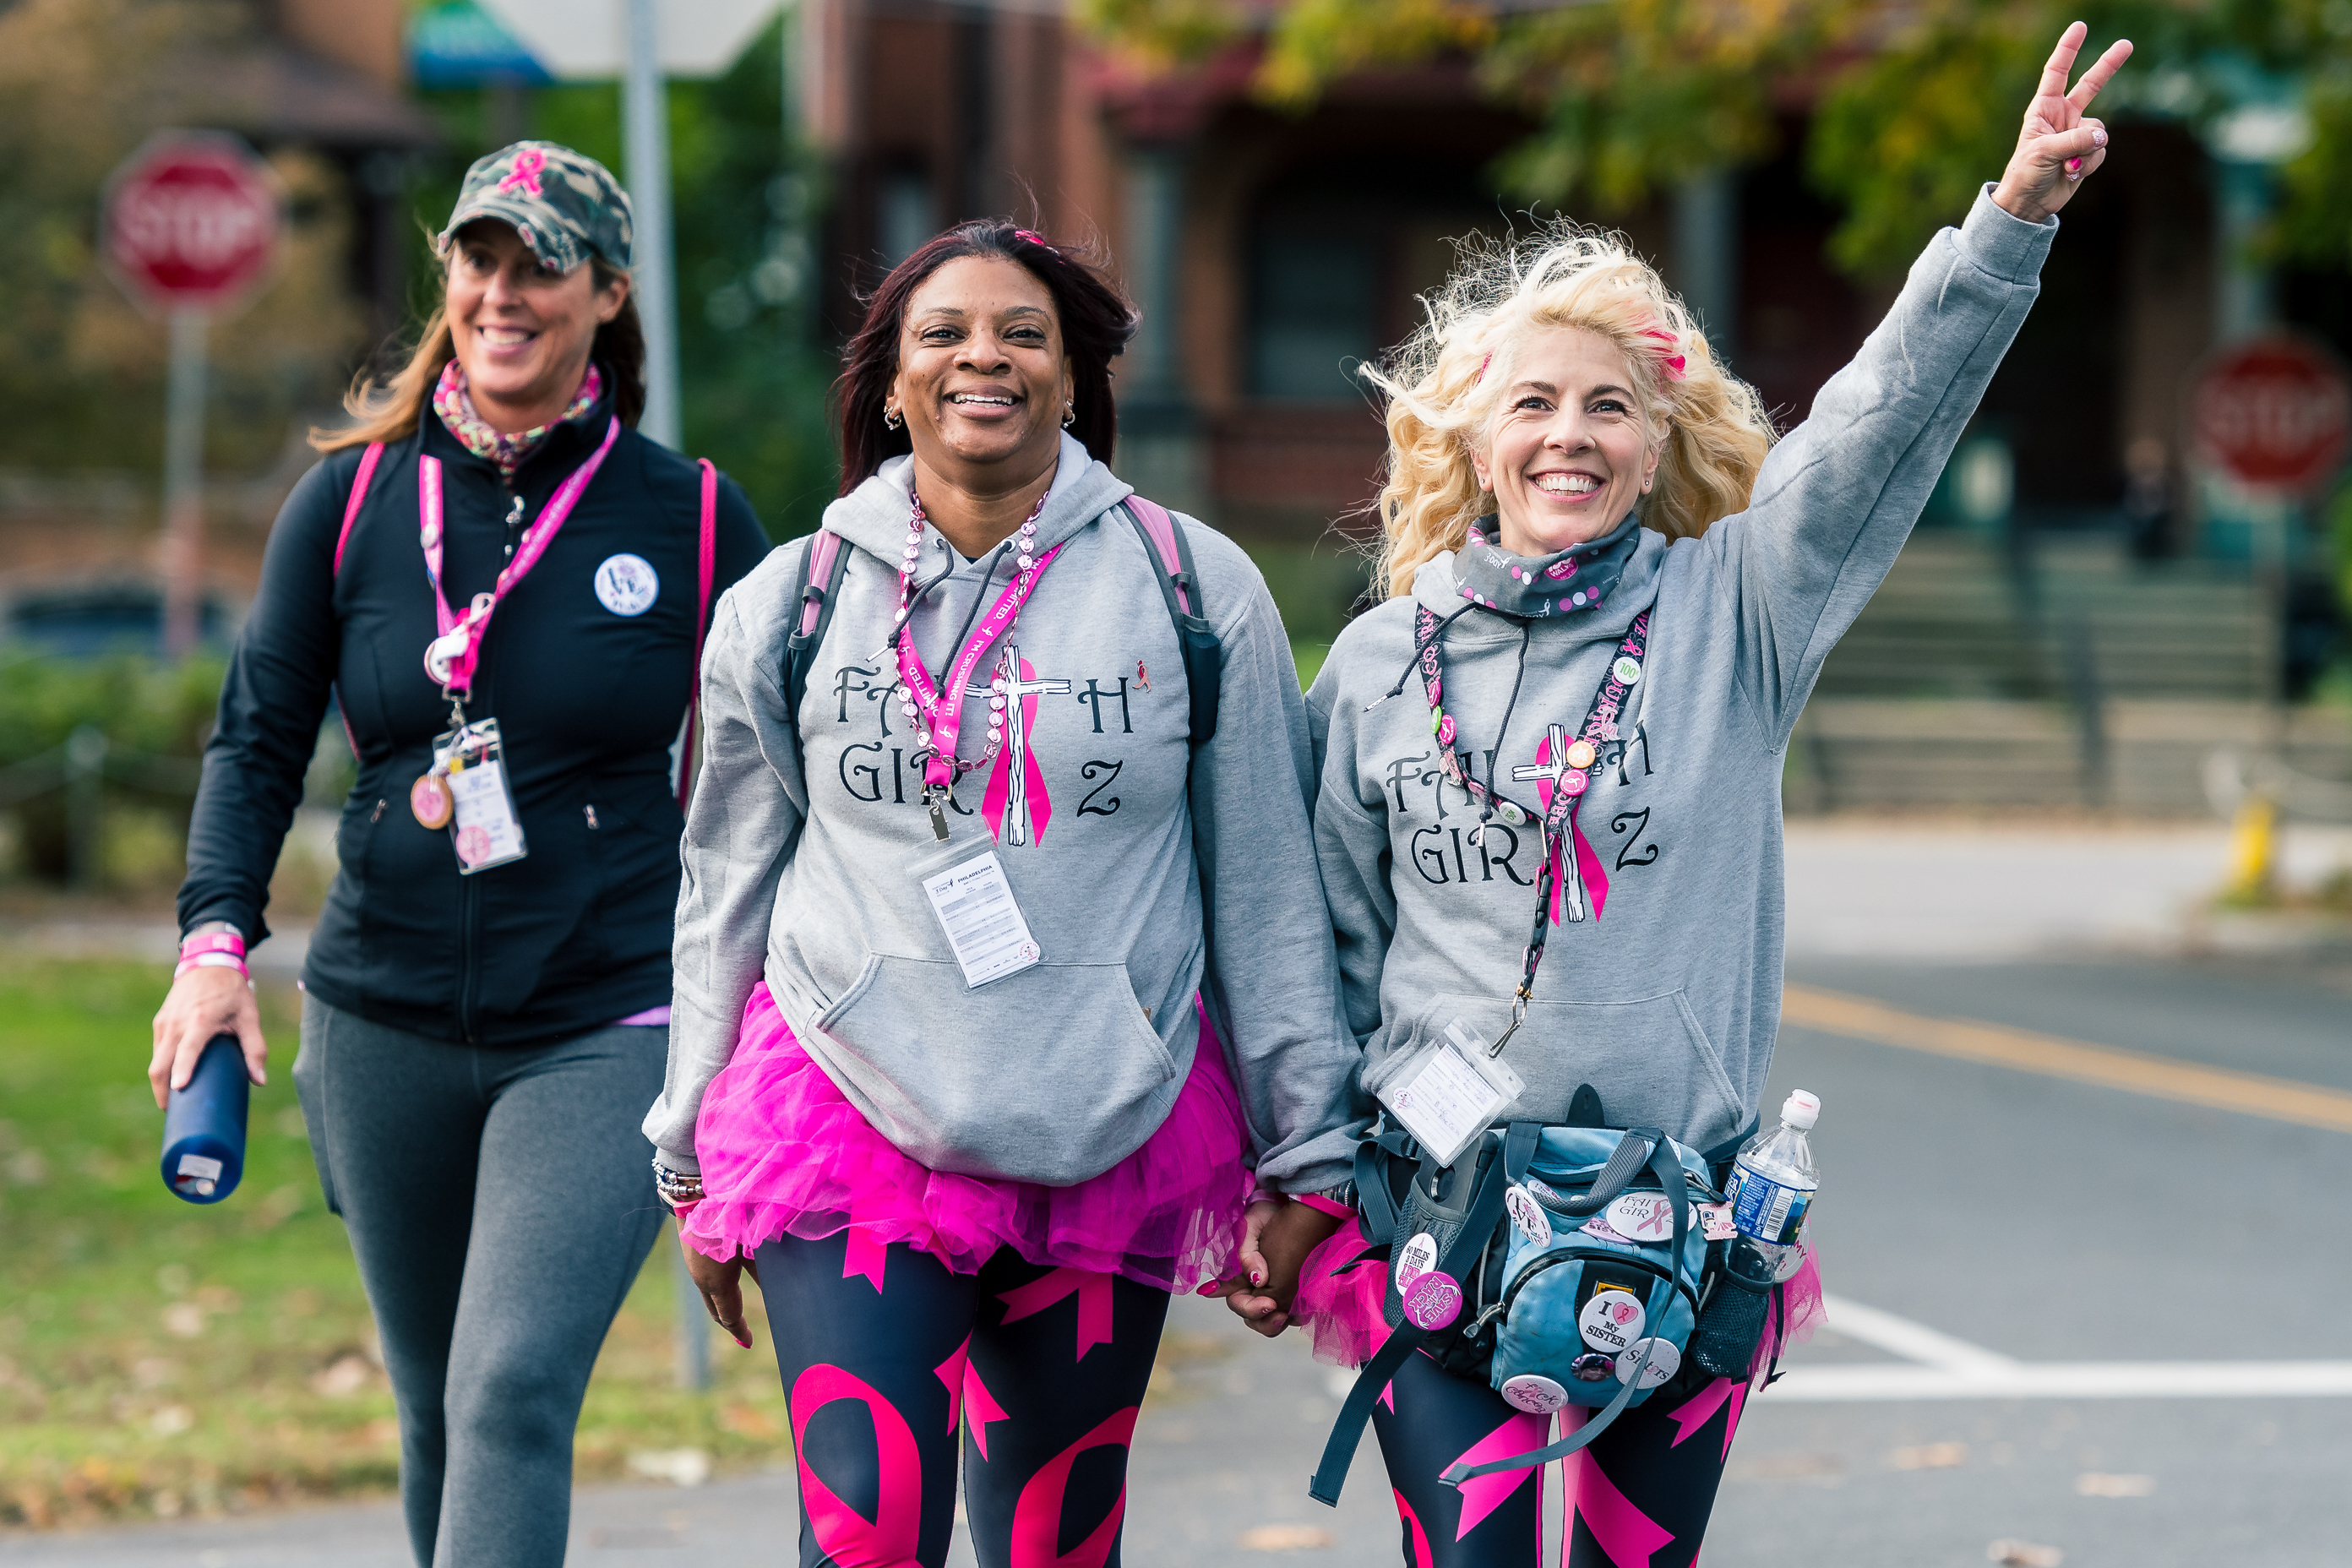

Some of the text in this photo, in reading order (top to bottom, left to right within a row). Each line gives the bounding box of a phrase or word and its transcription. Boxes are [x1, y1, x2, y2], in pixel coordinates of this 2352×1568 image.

[122, 184, 259, 261] STOP
[945, 640, 984, 717] I'M CRUSHING IT!
[957, 864, 993, 883] PHILADELPHIA
[1409, 1255, 1425, 1269] DAYS
[1413, 1247, 1430, 1262] MILES
[1407, 1275, 1445, 1313] RACK
[1424, 1293, 1453, 1323] SAVE
[1598, 1301, 1612, 1316] I
[1586, 1325, 1627, 1348] SISTER
[1603, 1320, 1620, 1333] My
